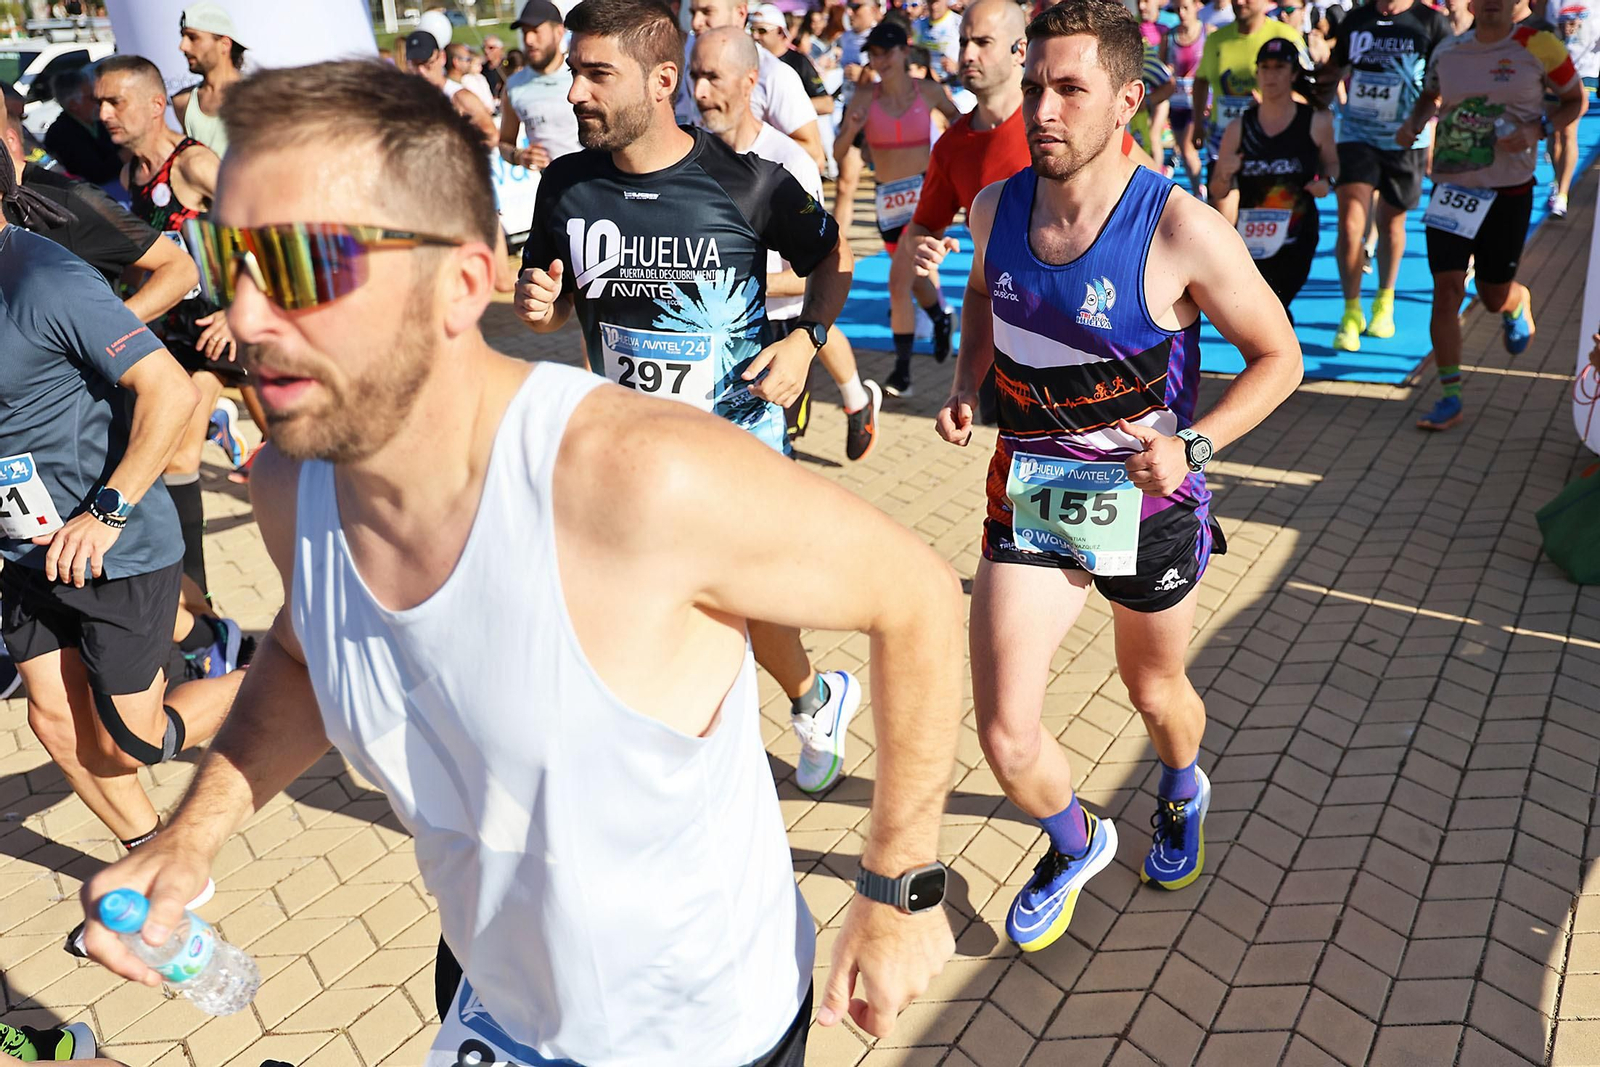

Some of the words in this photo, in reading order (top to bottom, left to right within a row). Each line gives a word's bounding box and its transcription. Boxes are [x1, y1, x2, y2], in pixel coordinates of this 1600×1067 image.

[1372, 38, 1414, 51] HUELVA
[1356, 84, 1390, 100] 344
[1440, 190, 1479, 213] 358
[1245, 221, 1278, 238] 999
[620, 236, 722, 269] HUELVA
[619, 268, 645, 280] PUERTA
[645, 269, 659, 280] DEL
[619, 335, 640, 347] HUELVA
[642, 340, 682, 352] AVATEL
[617, 356, 692, 394] 297
[1036, 463, 1065, 477] HUELVA
[1068, 469, 1110, 482] AVATEL
[1111, 468, 1130, 484] '2
[1030, 487, 1118, 526] 155
